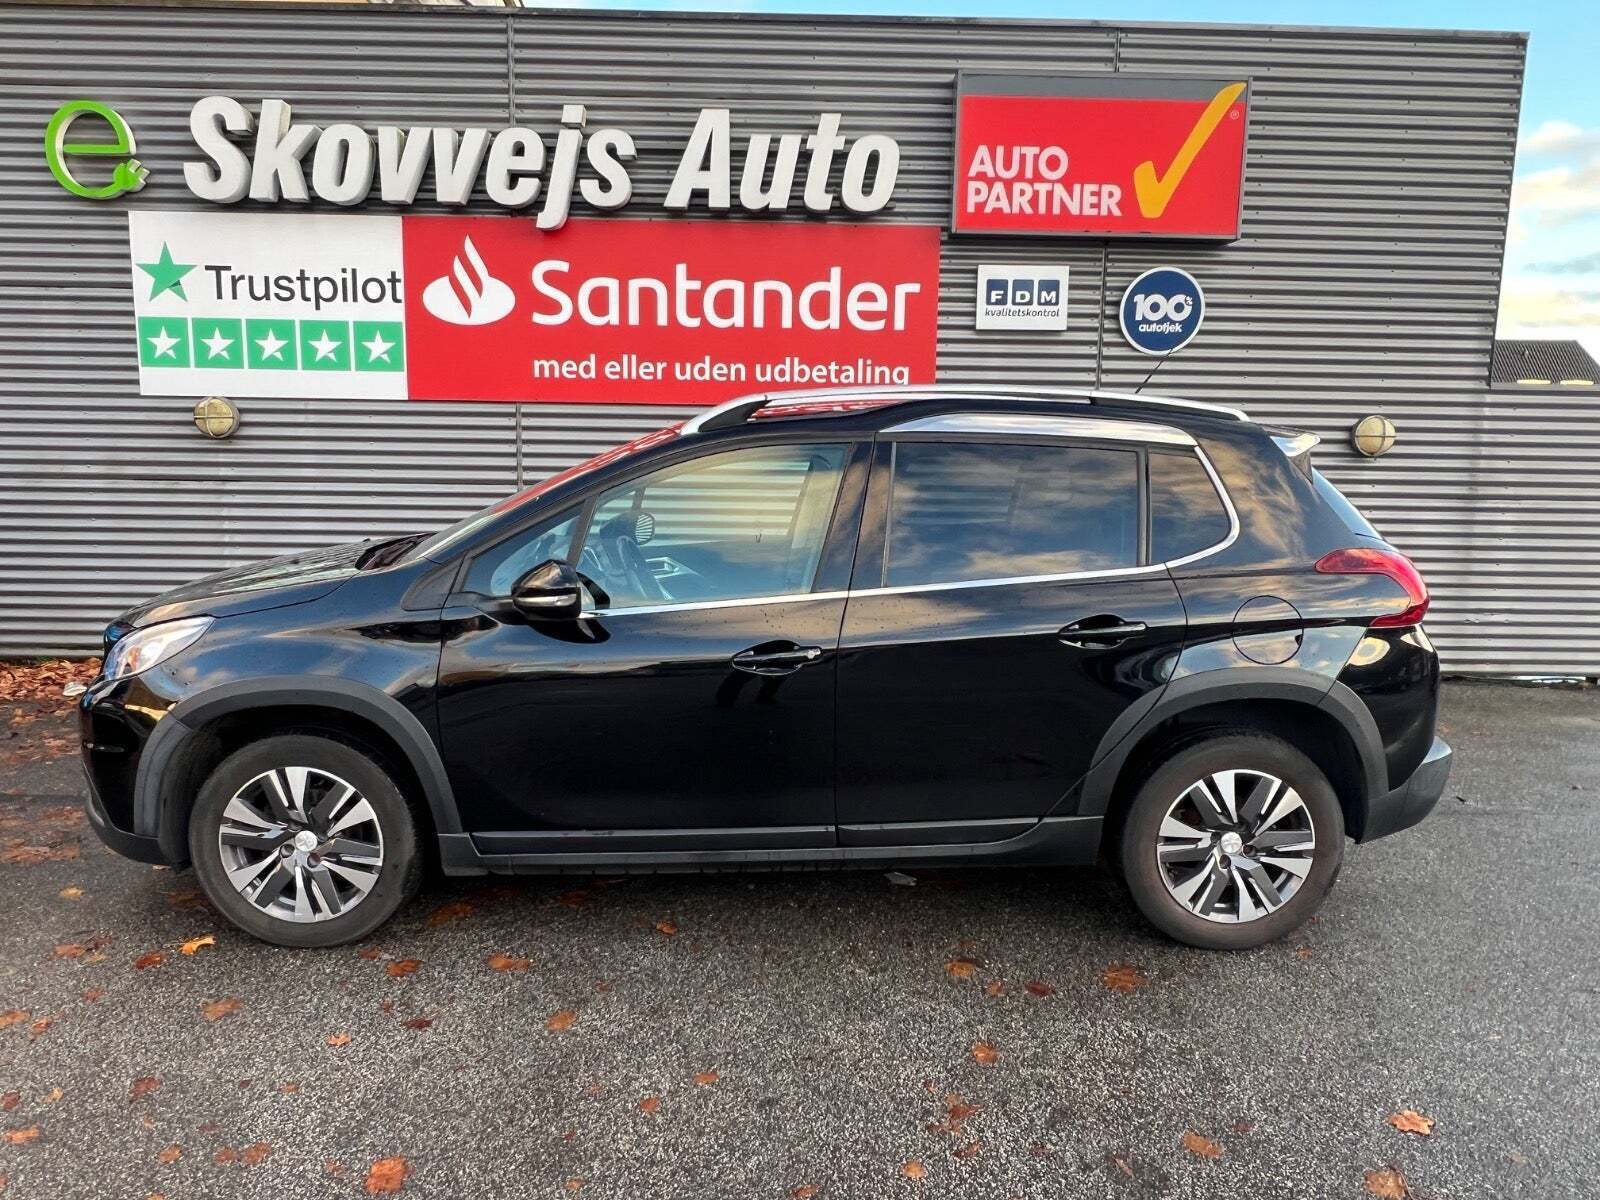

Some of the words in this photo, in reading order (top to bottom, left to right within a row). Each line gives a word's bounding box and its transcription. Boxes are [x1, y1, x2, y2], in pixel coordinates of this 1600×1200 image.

[183, 96, 638, 231] Skovvejs
[663, 108, 901, 214] Auto
[967, 145, 1069, 180] AUTO
[966, 180, 1122, 216] PARTNER
[204, 264, 402, 310] Trustpilot
[531, 259, 921, 331] Santander
[990, 290, 1057, 304] FDM
[984, 307, 1060, 318] kvalitetskontrol
[1138, 321, 1183, 335] autotjek
[533, 354, 596, 379] med
[604, 354, 667, 380] eller
[674, 355, 746, 382] uden
[755, 357, 910, 386] udbetaling
